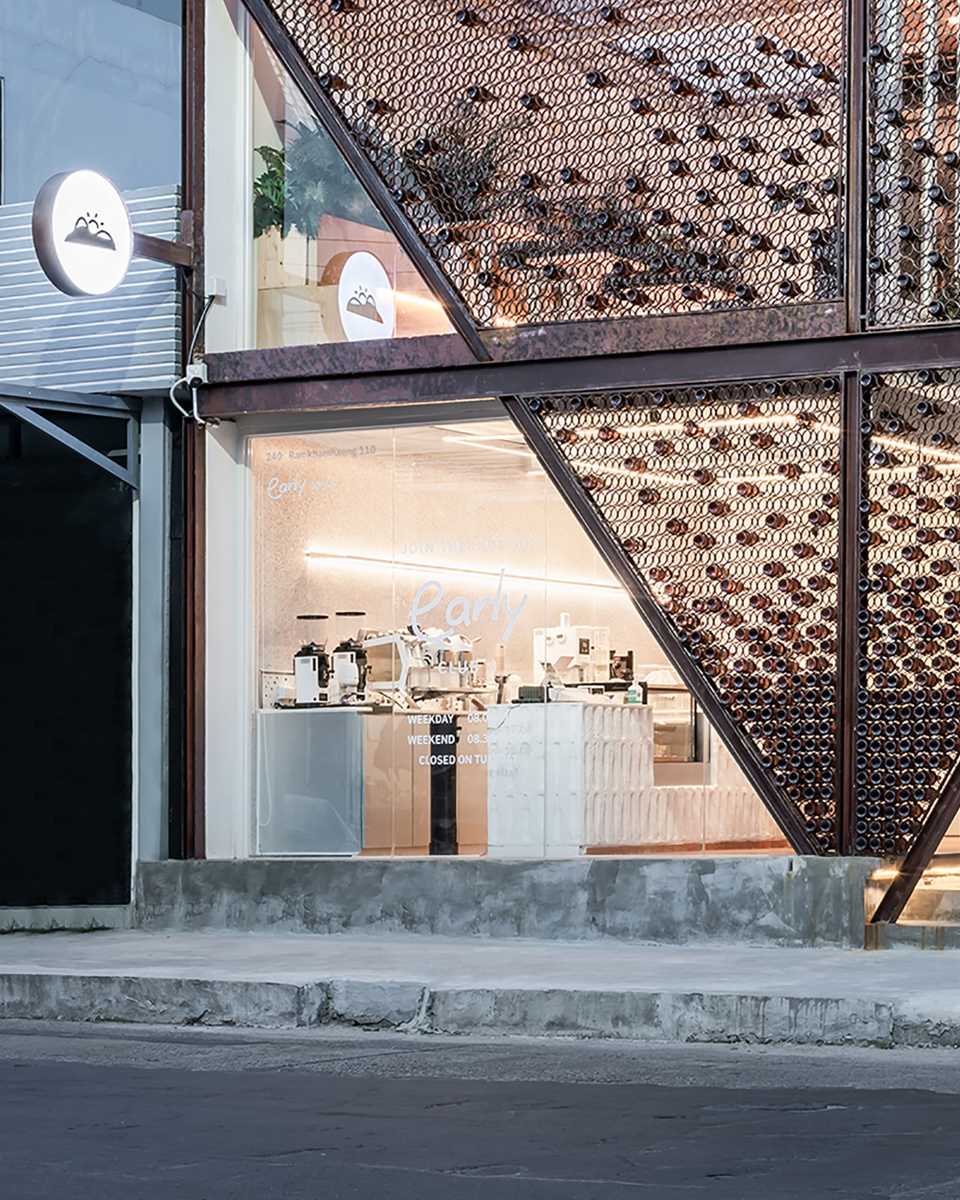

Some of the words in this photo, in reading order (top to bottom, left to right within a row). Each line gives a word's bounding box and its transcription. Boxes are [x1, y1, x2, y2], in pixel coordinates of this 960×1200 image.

[407, 714, 454, 725] WEEKDAY
[407, 734, 456, 745] WEEKEND
[418, 755, 456, 766] CLOSED
[457, 755, 473, 765] ON
